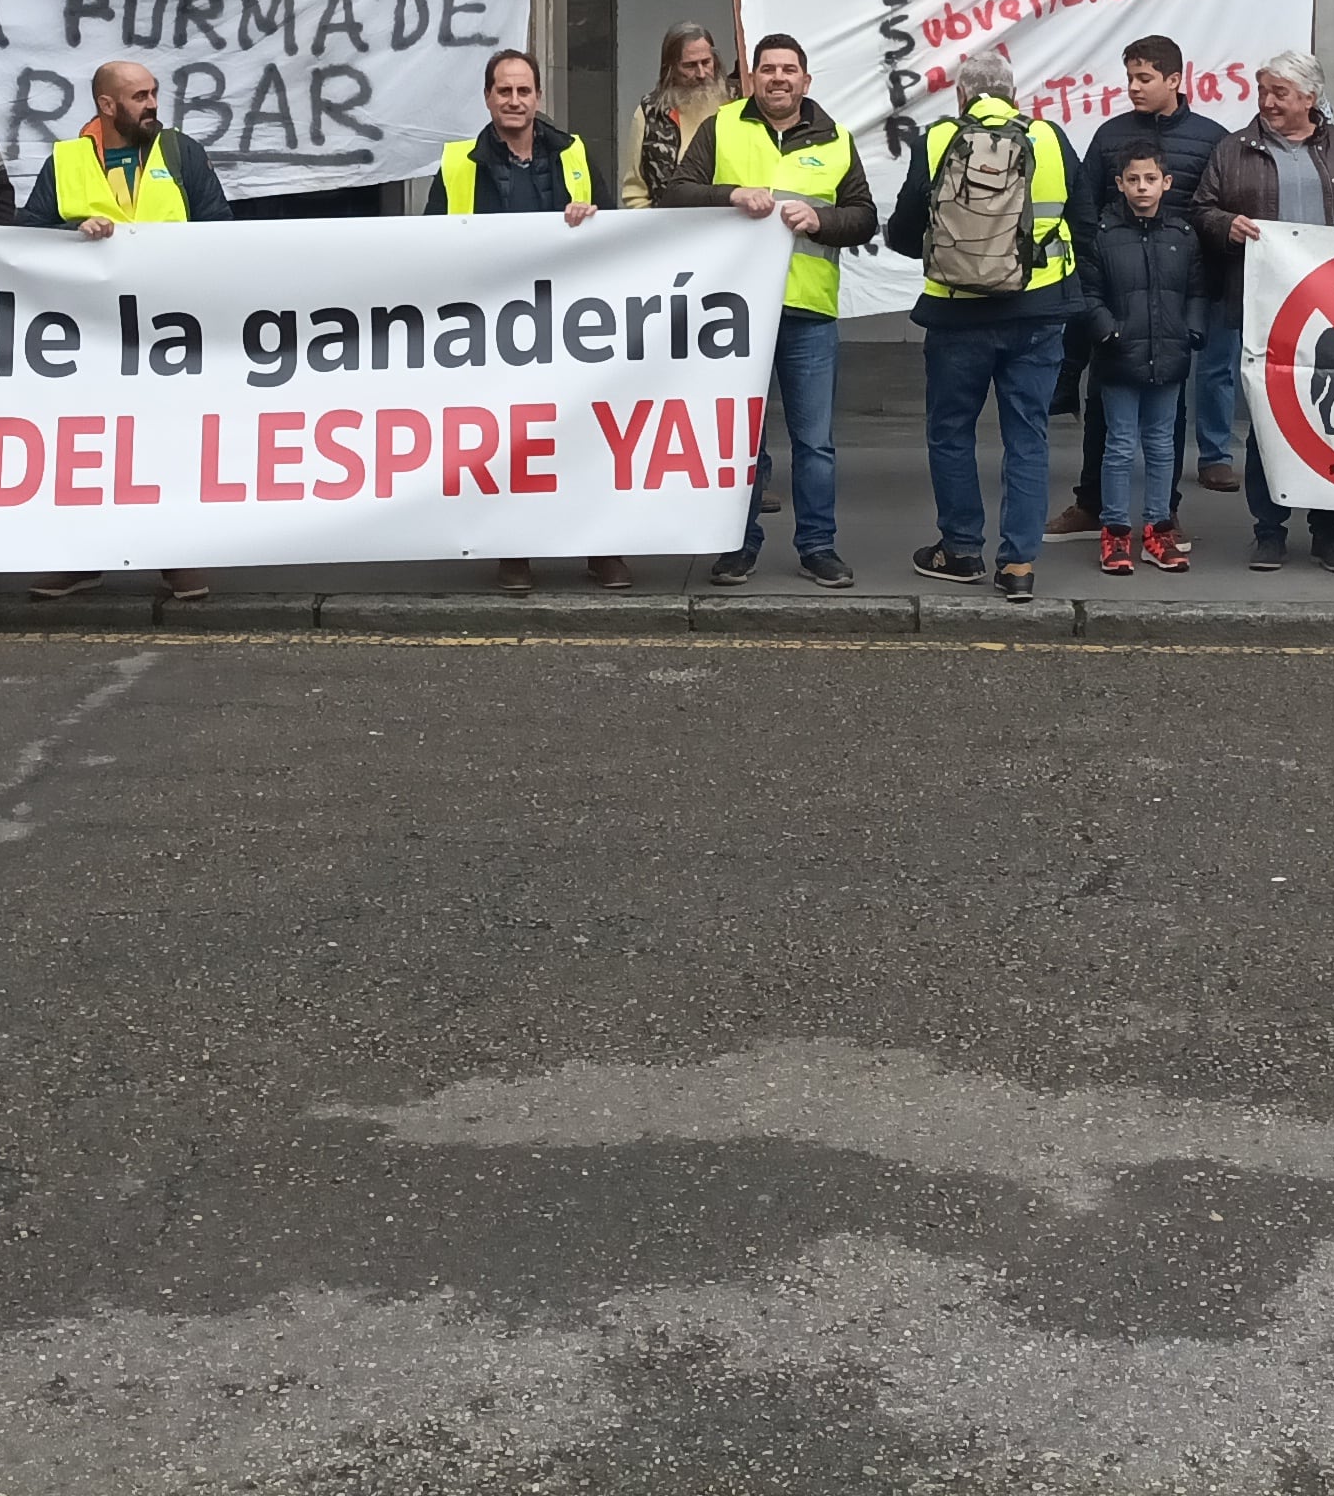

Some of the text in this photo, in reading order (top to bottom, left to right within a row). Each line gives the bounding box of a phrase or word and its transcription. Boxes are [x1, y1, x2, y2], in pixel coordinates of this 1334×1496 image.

[5, 60, 384, 160] RBAR
[119, 294, 203, 376] la
[243, 271, 750, 388] ganadería
[200, 403, 558, 503] LESPRE
[592, 396, 764, 491] YA!!
